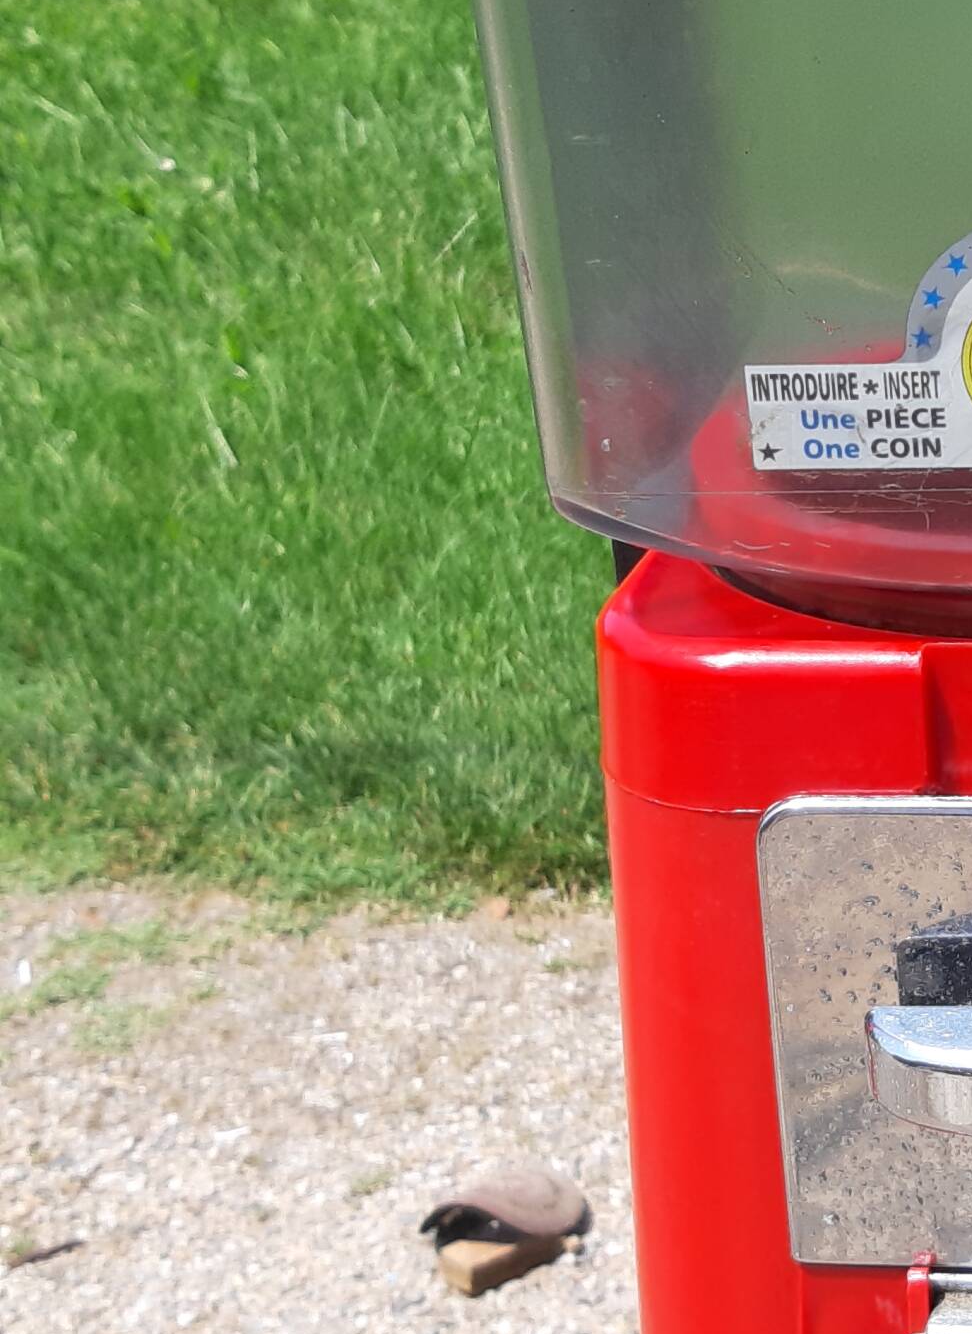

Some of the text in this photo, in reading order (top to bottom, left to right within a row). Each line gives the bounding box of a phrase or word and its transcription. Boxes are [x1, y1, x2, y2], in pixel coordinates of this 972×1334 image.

[751, 370, 940, 403] INTRODUIRE INSERT
[801, 402, 947, 430] Une PIÈCE
[804, 438, 942, 460] One COIN
